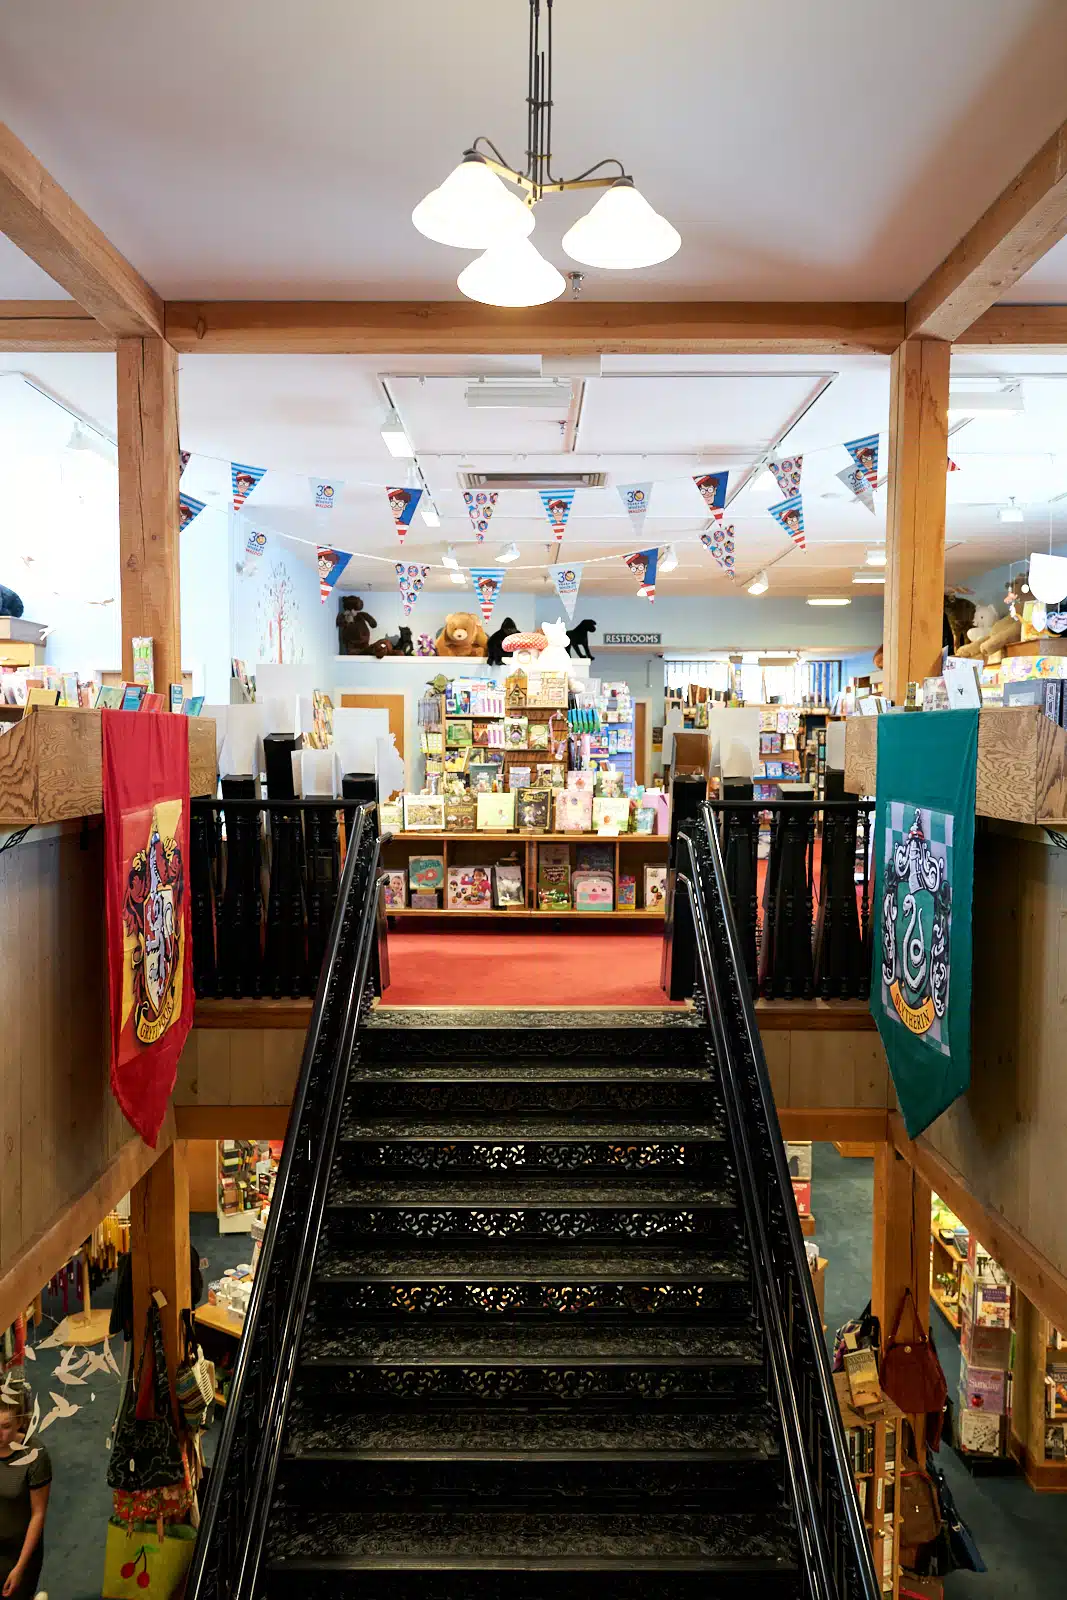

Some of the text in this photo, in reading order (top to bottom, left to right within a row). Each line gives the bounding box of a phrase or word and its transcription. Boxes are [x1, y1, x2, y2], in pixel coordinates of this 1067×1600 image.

[316, 485, 334, 497] 30
[627, 490, 644, 502] 30
[249, 531, 266, 545] 30
[557, 570, 575, 582] 30
[605, 634, 658, 643] RESTROOMS
[895, 993, 930, 1030] SLYTHERIN
